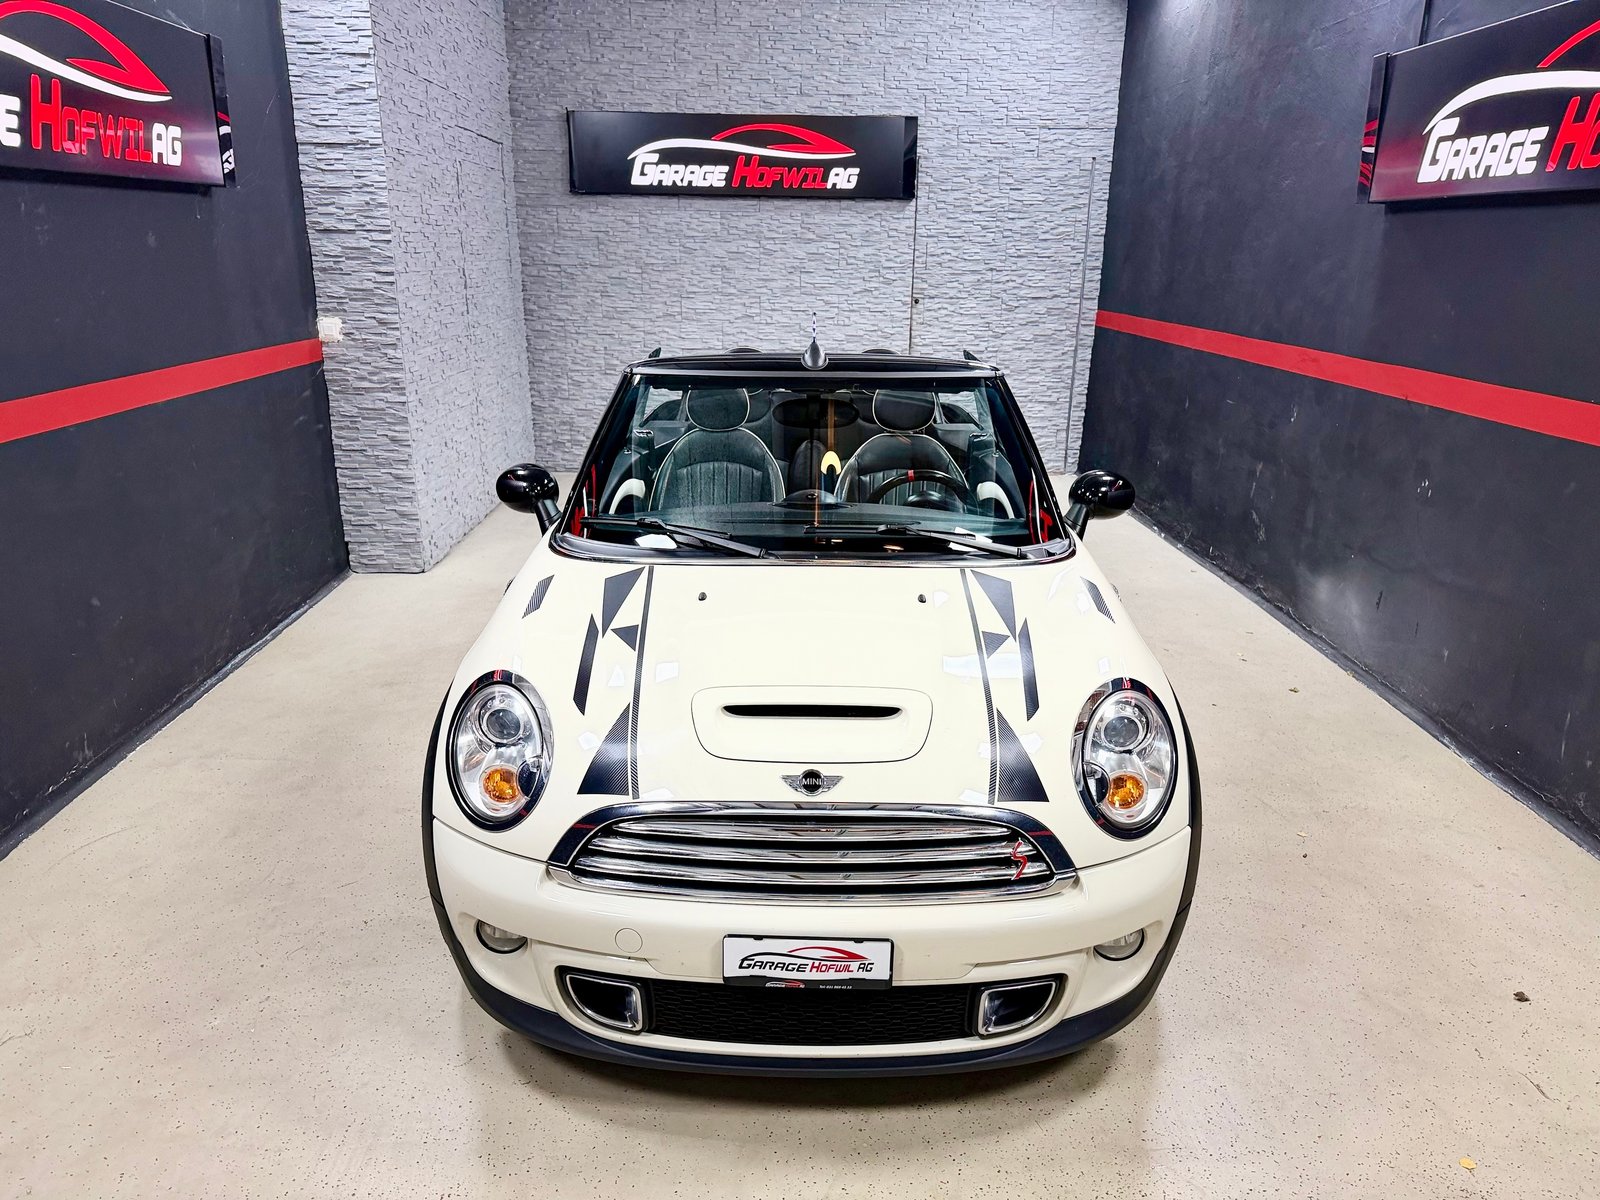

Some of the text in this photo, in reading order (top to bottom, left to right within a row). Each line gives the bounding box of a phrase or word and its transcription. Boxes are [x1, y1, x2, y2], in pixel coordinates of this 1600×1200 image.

[1416, 116, 1550, 183] GARAGE
[630, 153, 729, 188] GARAGE
[802, 777, 822, 785] MINI
[738, 958, 875, 973] GARAGE HOFWIL AG
